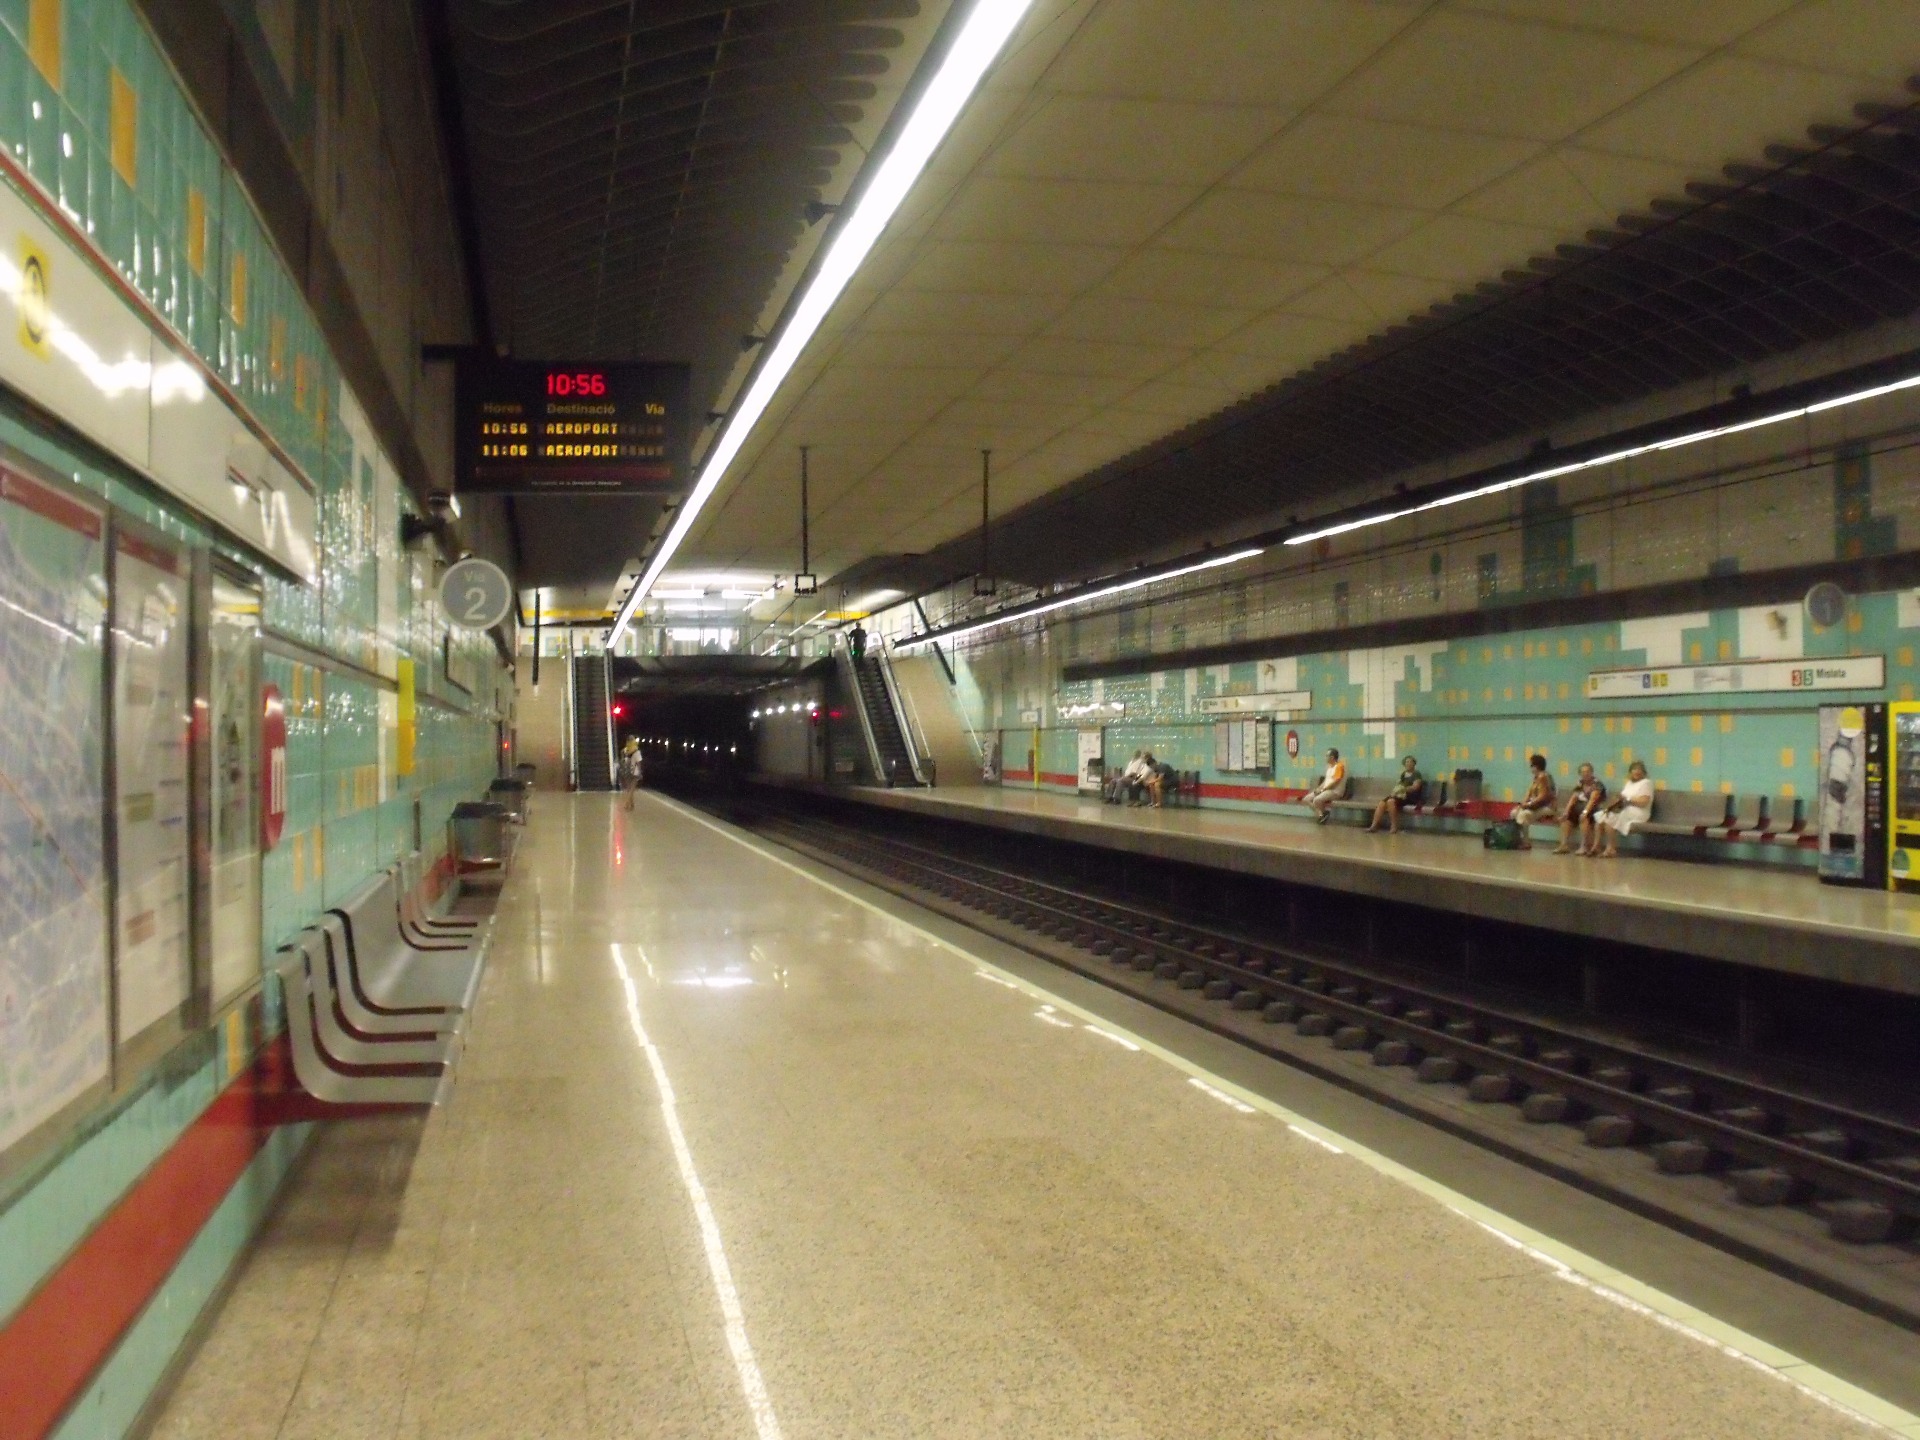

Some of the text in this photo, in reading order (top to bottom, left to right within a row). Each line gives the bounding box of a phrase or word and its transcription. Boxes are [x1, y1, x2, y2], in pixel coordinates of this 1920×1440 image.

[547, 373, 605, 395] 10:56
[547, 402, 616, 414] Destinació
[483, 423, 618, 434] 10:56 AEROPORT
[483, 445, 618, 456] 11:06 AEROPORT
[464, 587, 486, 619] 2
